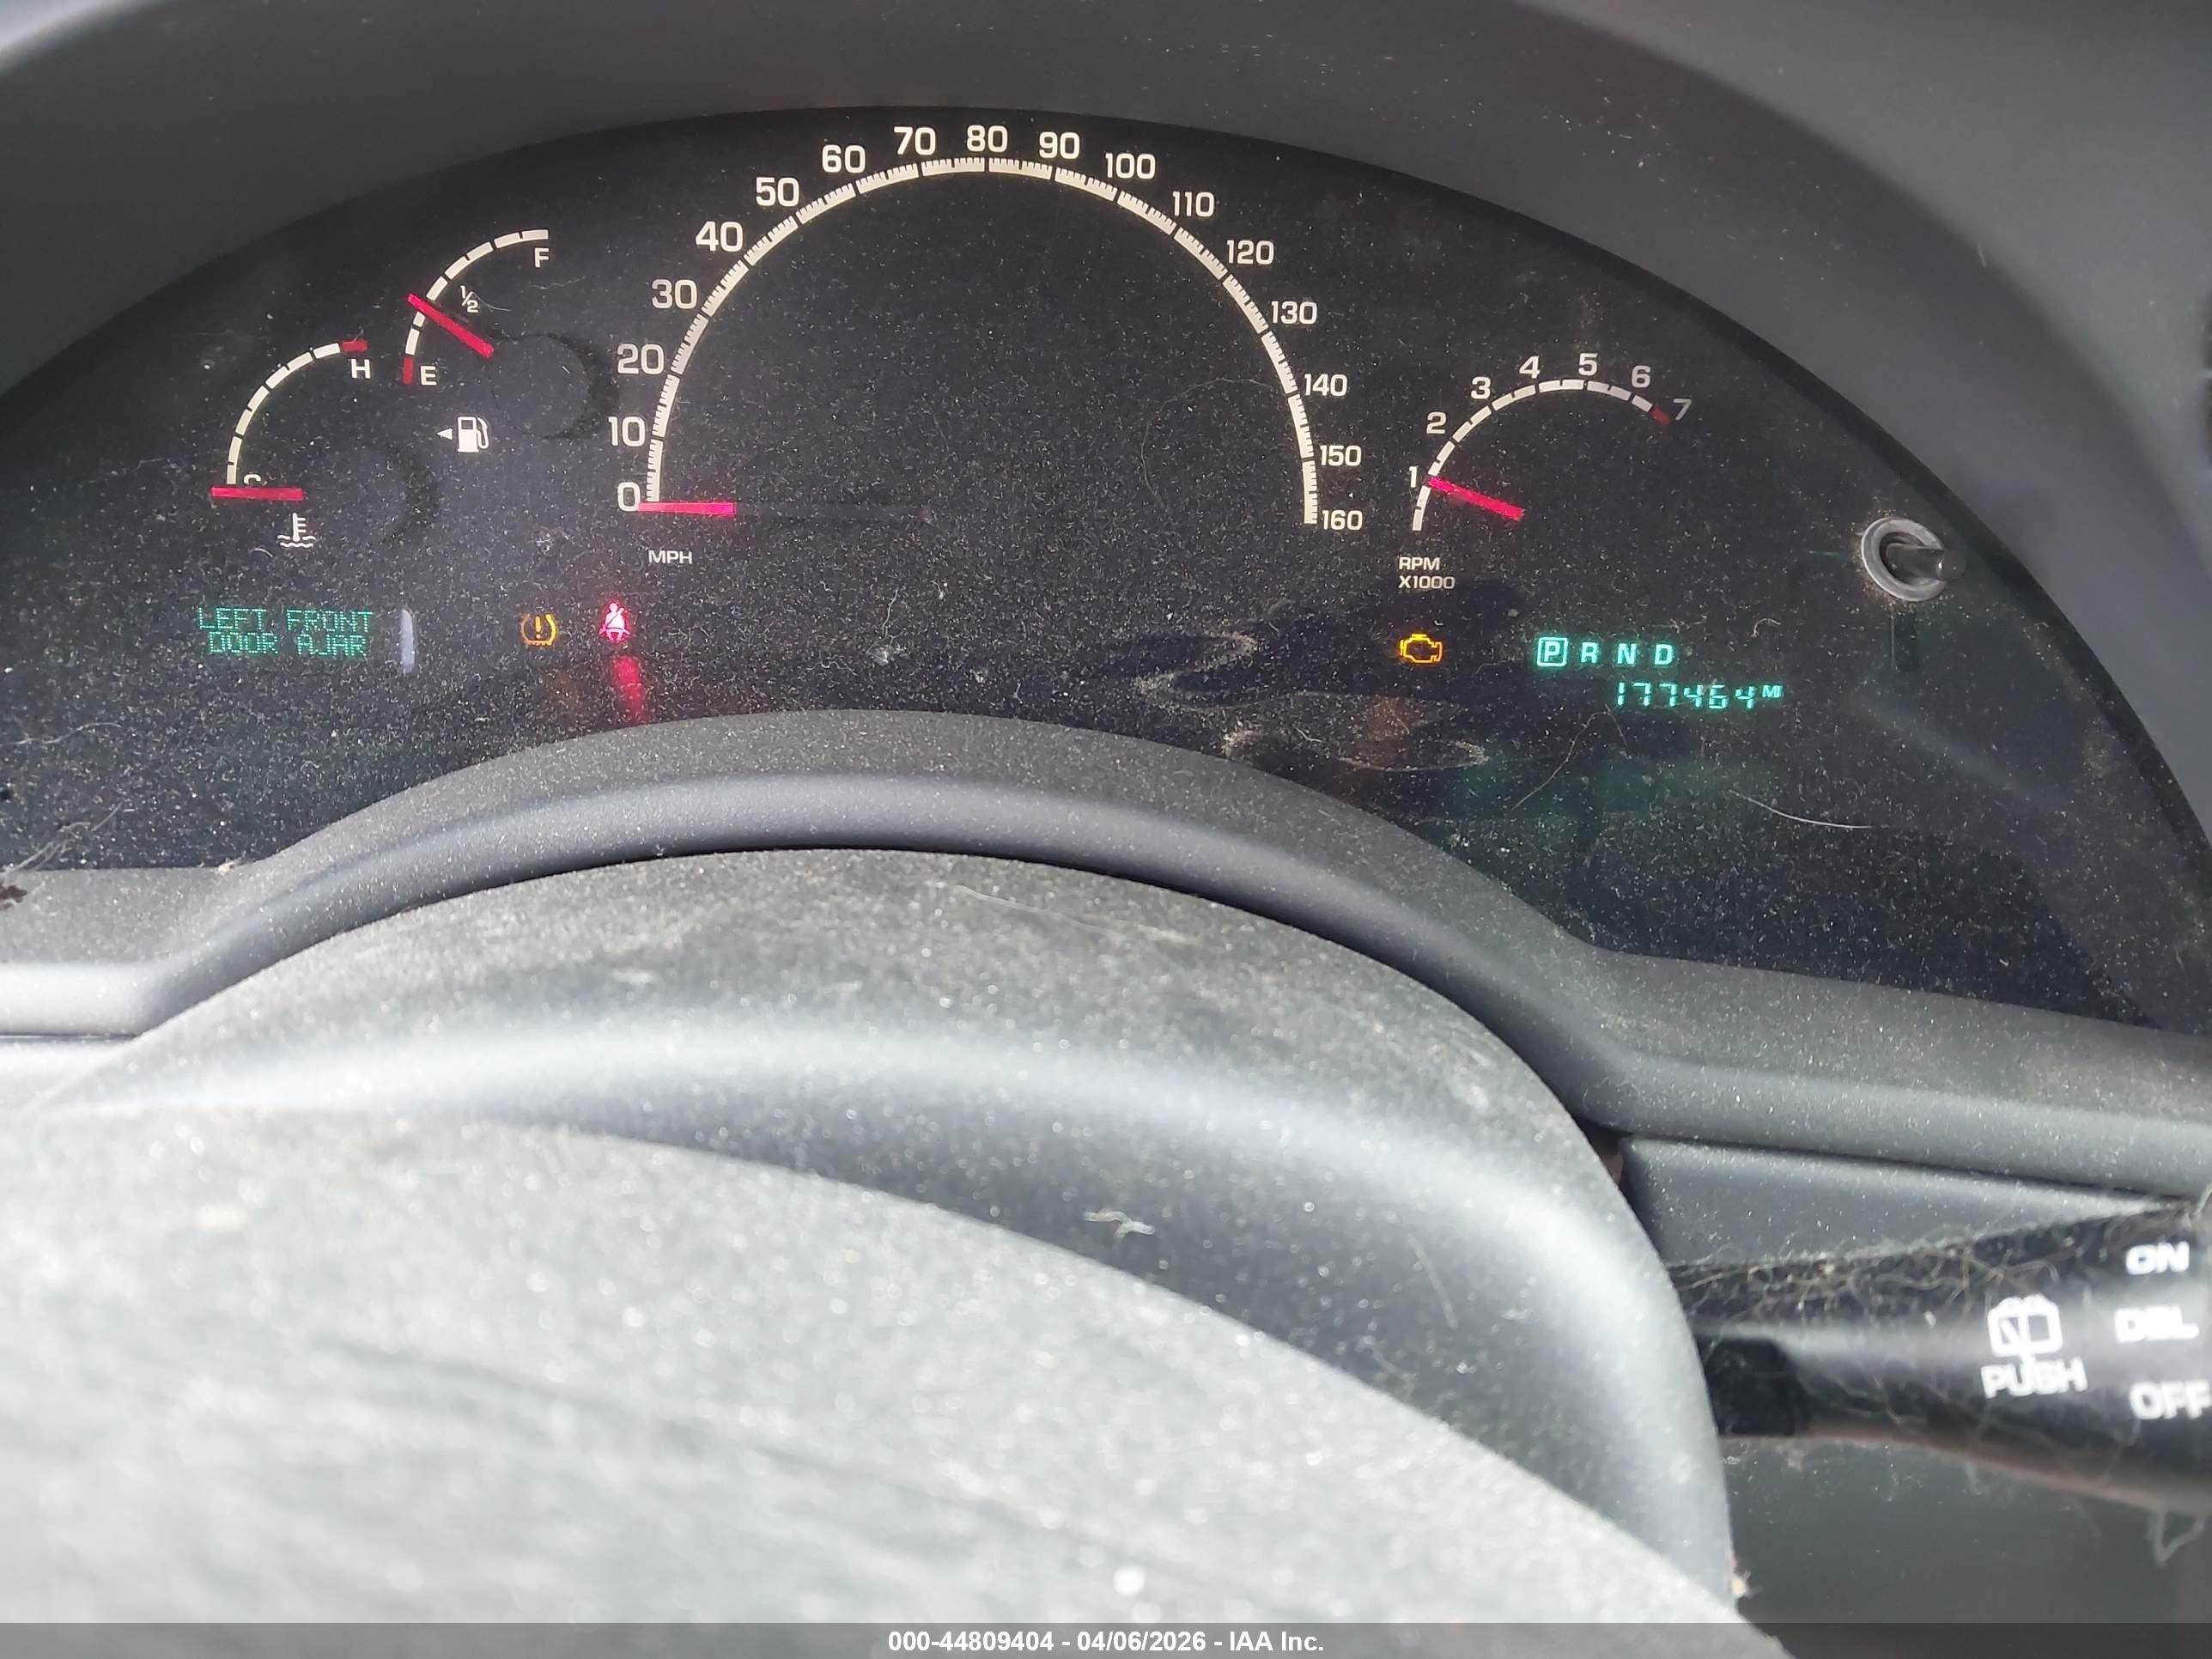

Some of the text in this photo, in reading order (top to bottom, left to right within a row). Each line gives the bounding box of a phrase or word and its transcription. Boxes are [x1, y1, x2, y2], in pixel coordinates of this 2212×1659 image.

[894, 126, 936, 155] 70
[967, 125, 1007, 152] 80
[1039, 132, 1079, 159] 90
[822, 144, 866, 173] 60
[1106, 153, 1155, 179] 100
[756, 177, 799, 206] 50
[1173, 191, 1214, 216] 110
[696, 221, 743, 252] 40
[534, 247, 550, 268] F
[1227, 240, 1273, 264] 120
[651, 279, 697, 309] 30
[1272, 301, 1317, 324] 130
[351, 359, 371, 379] H
[617, 343, 665, 374] 20
[1519, 356, 1540, 379] 4
[1578, 353, 1597, 376] 5
[420, 366, 438, 386] E
[1304, 374, 1347, 396] 140
[1471, 377, 1491, 399] 3
[1632, 365, 1650, 388] 6
[1673, 398, 1692, 420] 7
[608, 416, 646, 447] 10
[1426, 412, 1446, 434] 2
[1320, 445, 1362, 466] 150
[1408, 465, 1419, 488] 1
[617, 482, 640, 512] 0
[1322, 510, 1363, 531] 160
[648, 549, 693, 565] MPH
[1399, 556, 1440, 571] RPM
[1398, 575, 1455, 590] X1000
[198, 607, 374, 633] LEFT FRONT
[209, 631, 368, 656] DOOR AJAR
[1580, 641, 1599, 664] R
[1617, 642, 1637, 665] N
[1654, 643, 1674, 665] D
[1616, 681, 1756, 709] 177464
[2125, 1241, 2190, 1275] ON
[1980, 1356, 2088, 1399] PUSH
[2129, 1378, 2212, 1420] OFF
